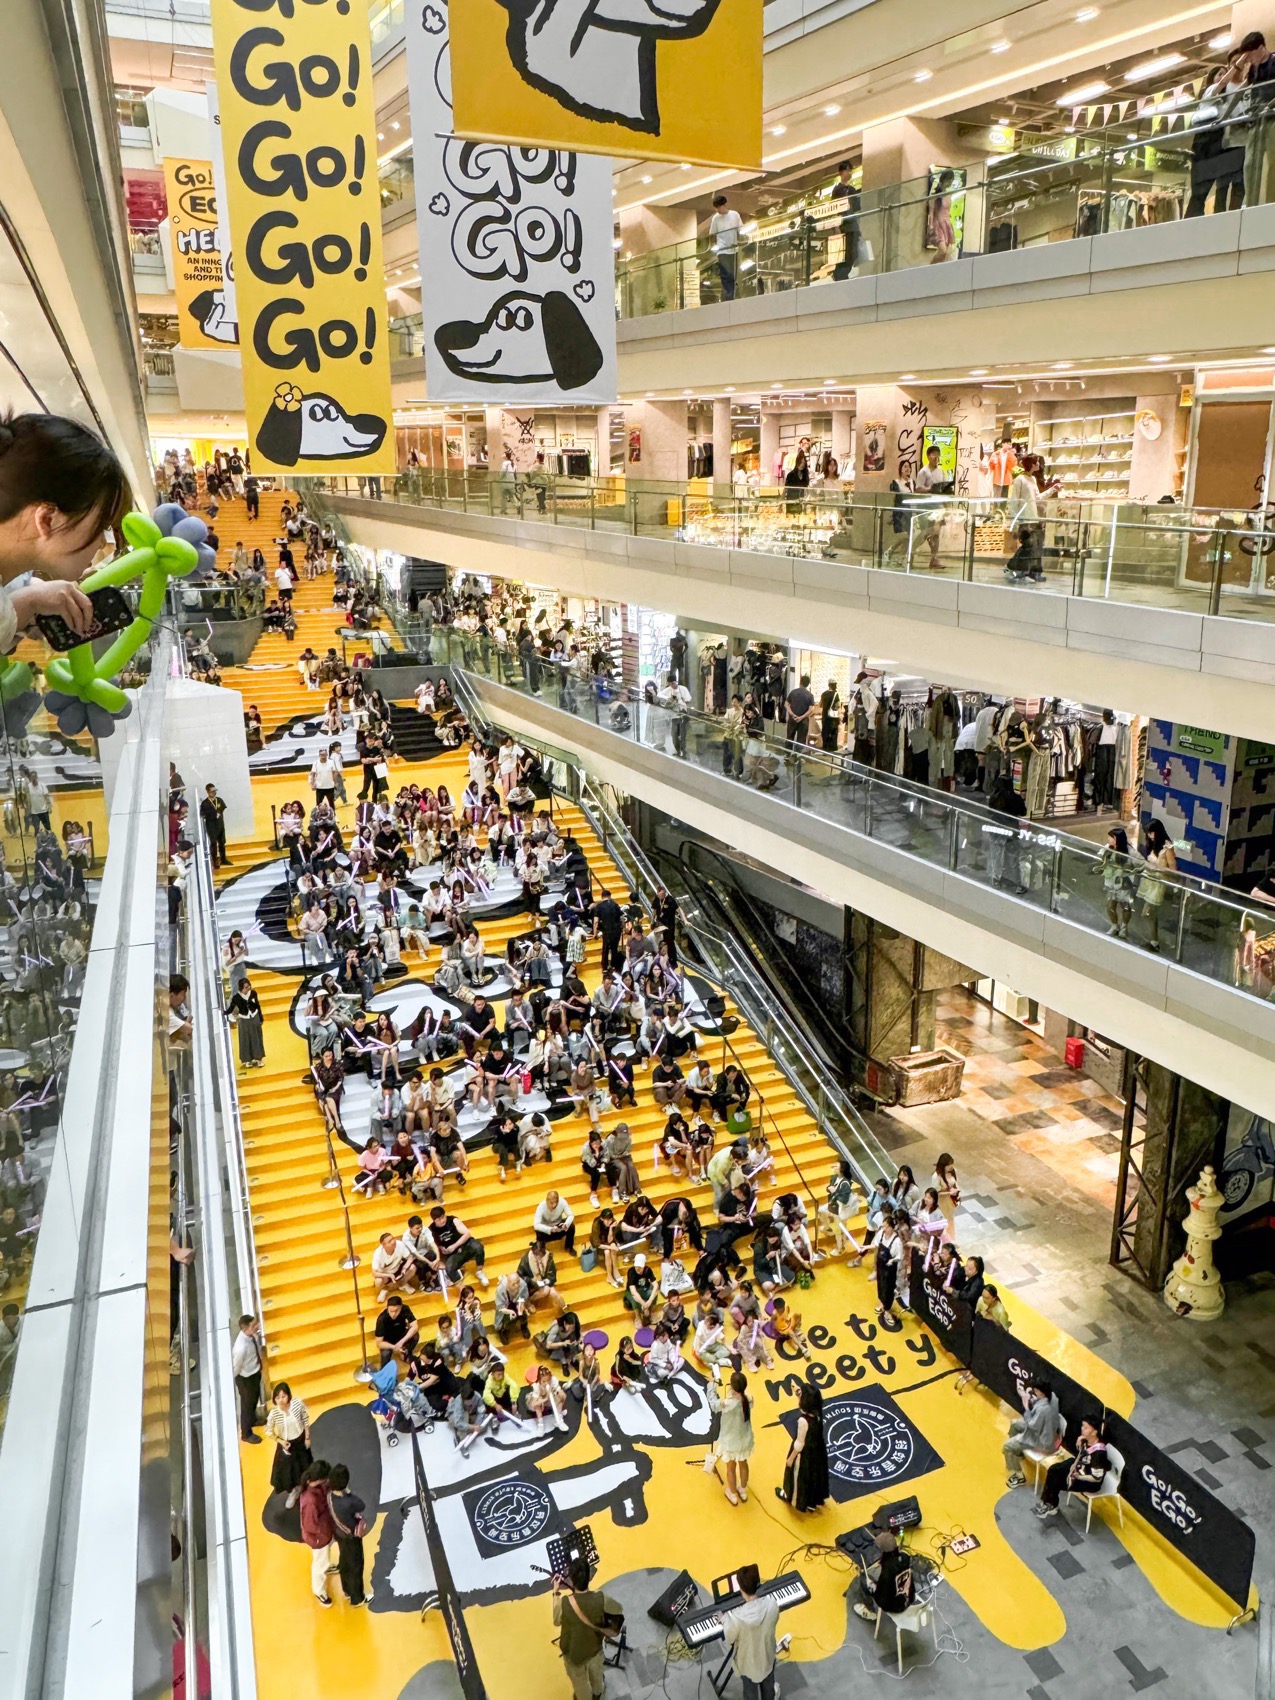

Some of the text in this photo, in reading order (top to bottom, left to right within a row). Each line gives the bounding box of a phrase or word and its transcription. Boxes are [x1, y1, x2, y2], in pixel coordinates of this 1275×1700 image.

[230, 27, 359, 112] Go!
[175, 165, 213, 188] Go!
[238, 120, 365, 202] Go!
[194, 265, 213, 274] AND
[246, 210, 371, 289] Go!
[451, 199, 583, 282] Go!
[253, 297, 376, 373] Go!
[764, 1344, 896, 1401] meet
